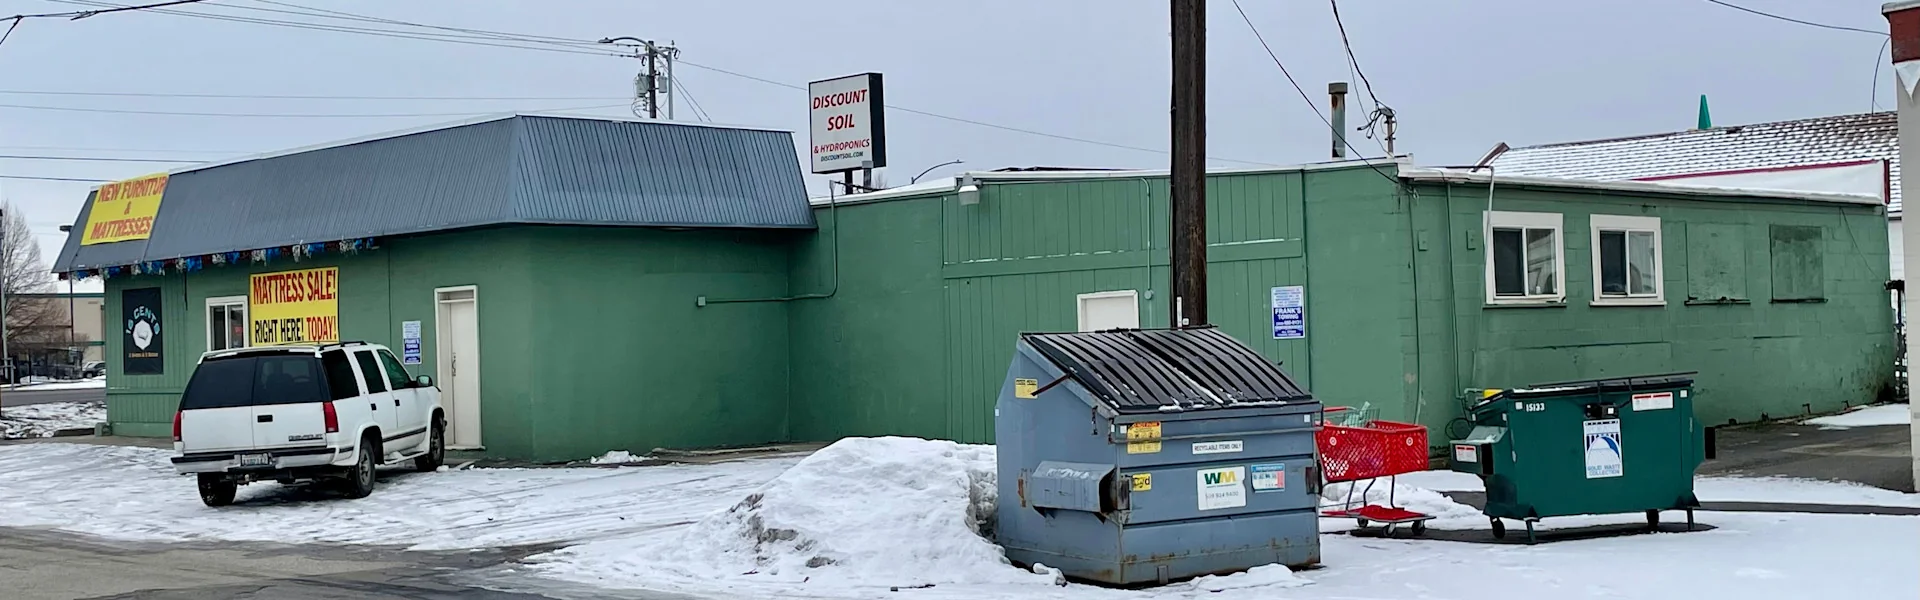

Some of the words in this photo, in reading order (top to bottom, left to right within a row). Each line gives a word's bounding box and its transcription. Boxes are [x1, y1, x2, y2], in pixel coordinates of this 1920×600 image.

[813, 89, 867, 110] DISCOUNT
[827, 113, 855, 131] SOIL
[814, 145, 819, 154] &
[820, 138, 870, 153] HYDROPONICS
[821, 151, 864, 162] DISCOUNTSOIL.COM
[98, 183, 120, 203] NEW
[121, 176, 167, 200] FURNITUR
[124, 201, 132, 215] &
[90, 216, 153, 240] MATTRESSES
[252, 272, 305, 305] MATTRESS
[307, 269, 336, 301] SALE!
[255, 319, 278, 343] RIGHT
[280, 317, 304, 342] HERE!
[306, 315, 337, 342] TODAY!
[1204, 471, 1237, 485] WM
